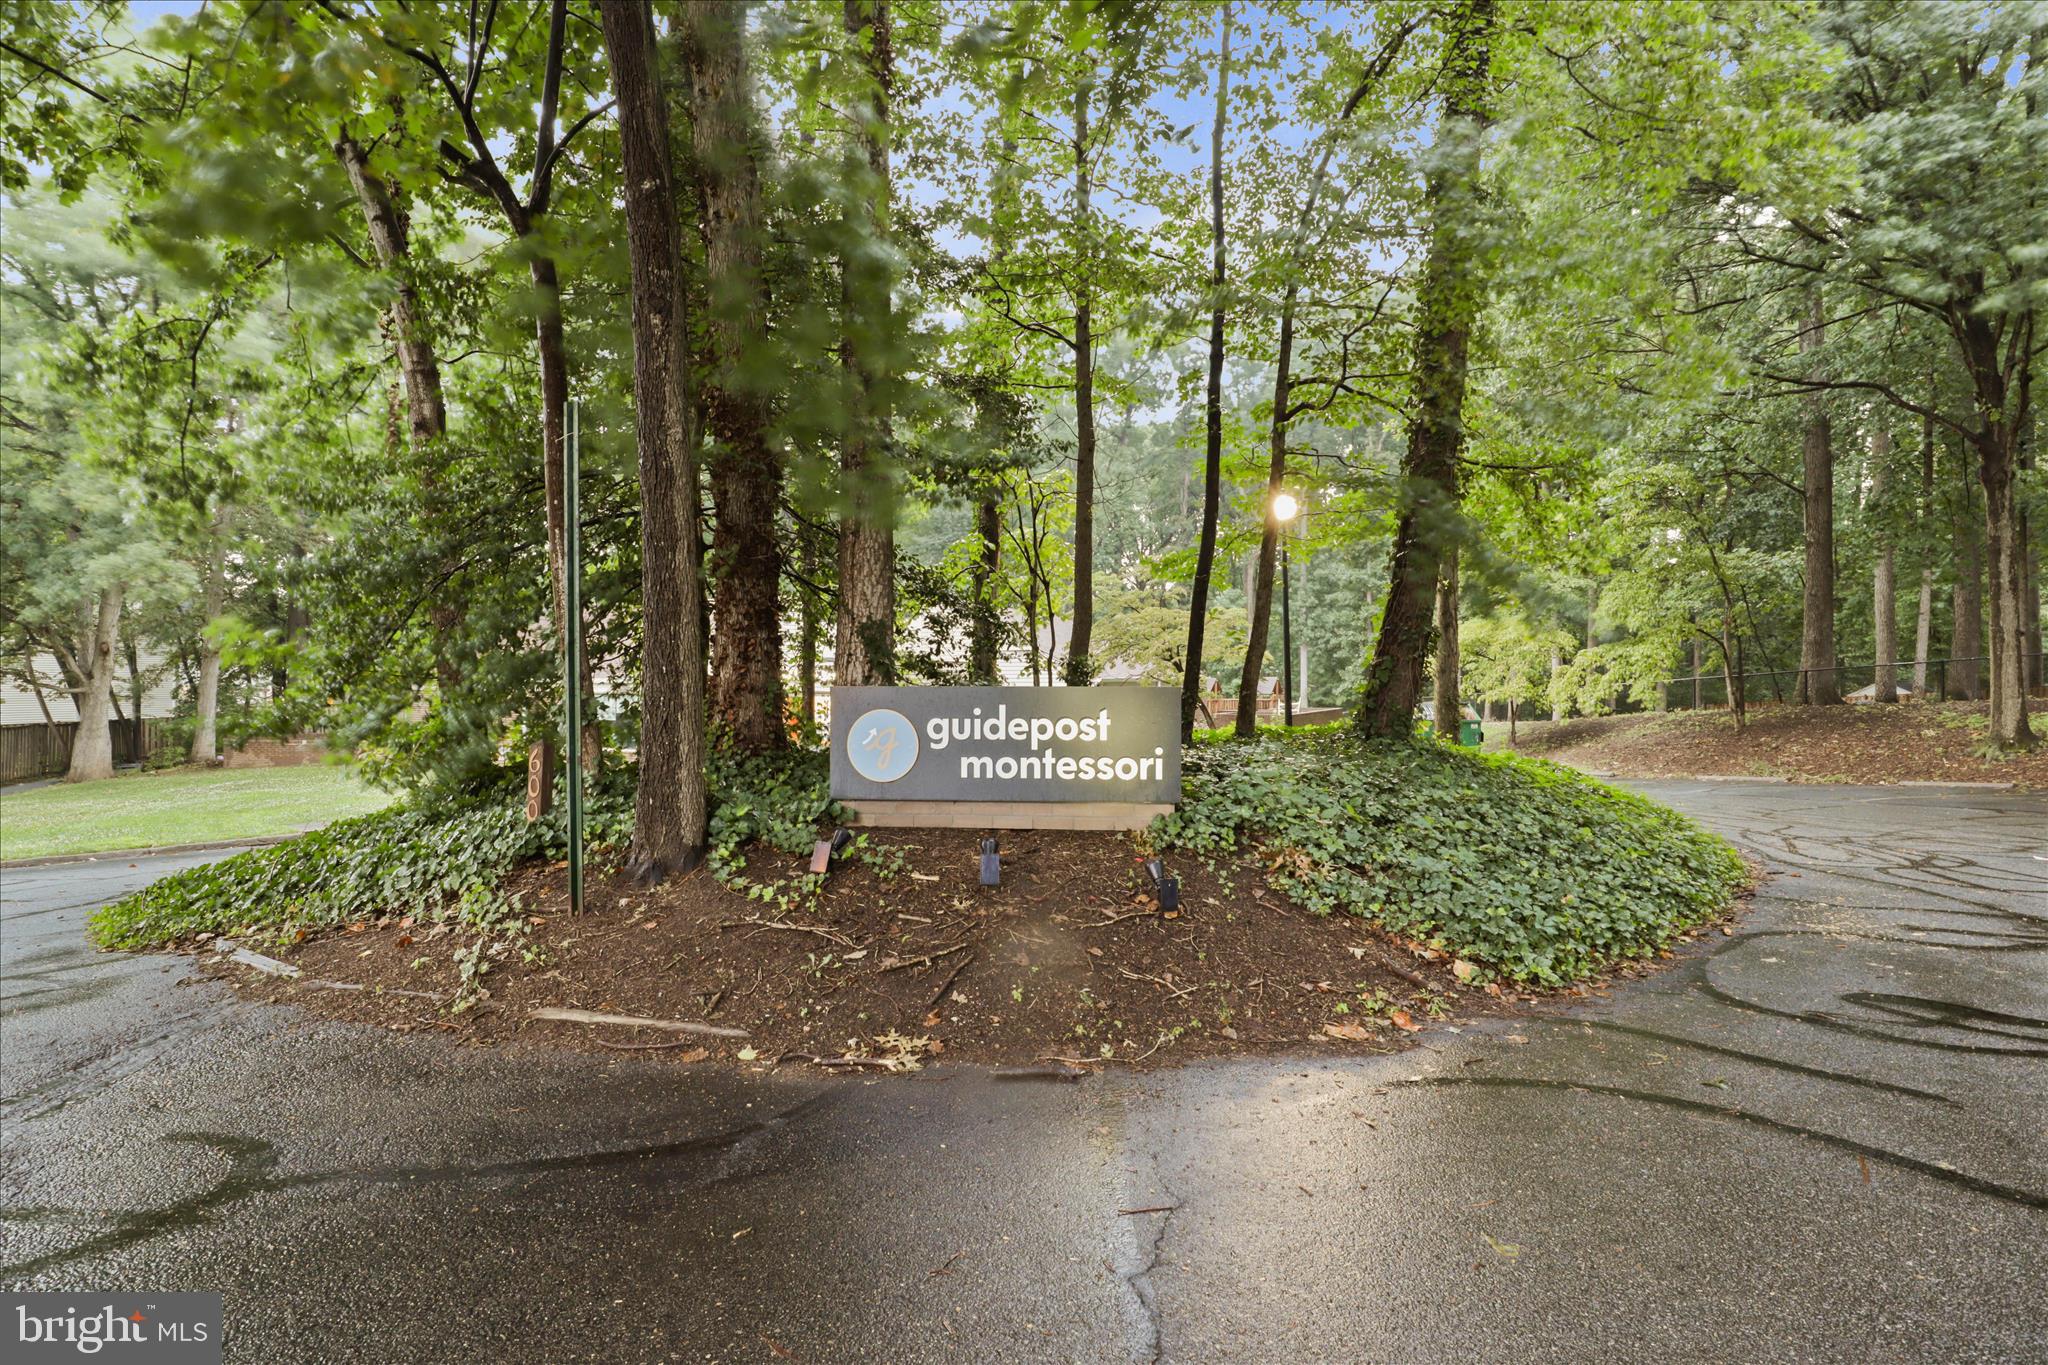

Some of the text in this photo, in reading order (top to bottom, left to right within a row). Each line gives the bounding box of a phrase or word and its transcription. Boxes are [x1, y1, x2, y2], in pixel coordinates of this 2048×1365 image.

[926, 704, 1111, 751] guidepost
[527, 749, 540, 821] 600
[960, 747, 1164, 781] montessori
